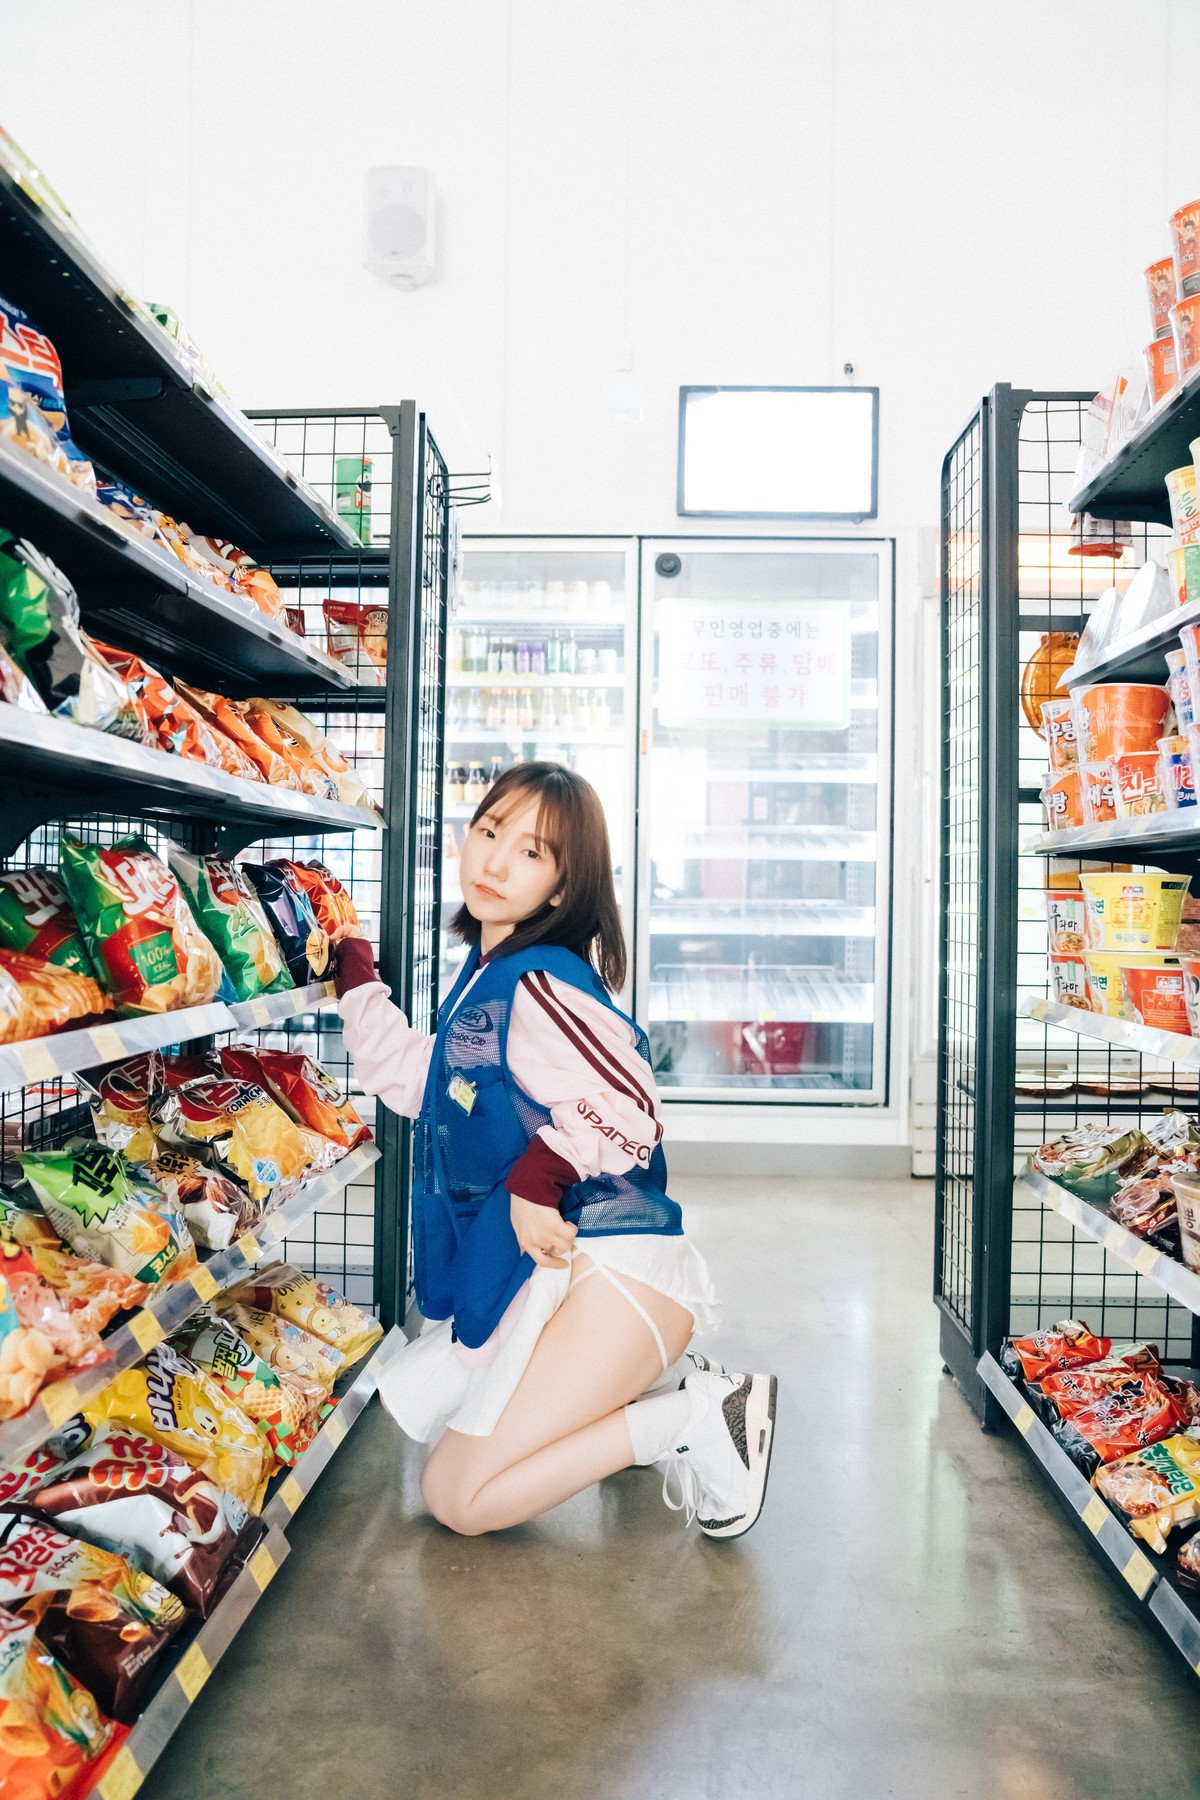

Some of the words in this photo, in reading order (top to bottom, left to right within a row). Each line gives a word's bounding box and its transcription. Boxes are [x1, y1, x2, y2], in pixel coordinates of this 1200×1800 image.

[690, 619, 821, 640] 무인영업중에는
[792, 651, 836, 676] 담배
[703, 682, 749, 708] 판매
[761, 683, 807, 708] 불가
[1087, 781, 1115, 808] 새우
[1120, 769, 1164, 805] 진라
[226, 1093, 252, 1115] CORN
[248, 1084, 266, 1102] CH
[72, 1150, 122, 1198] 꼬북
